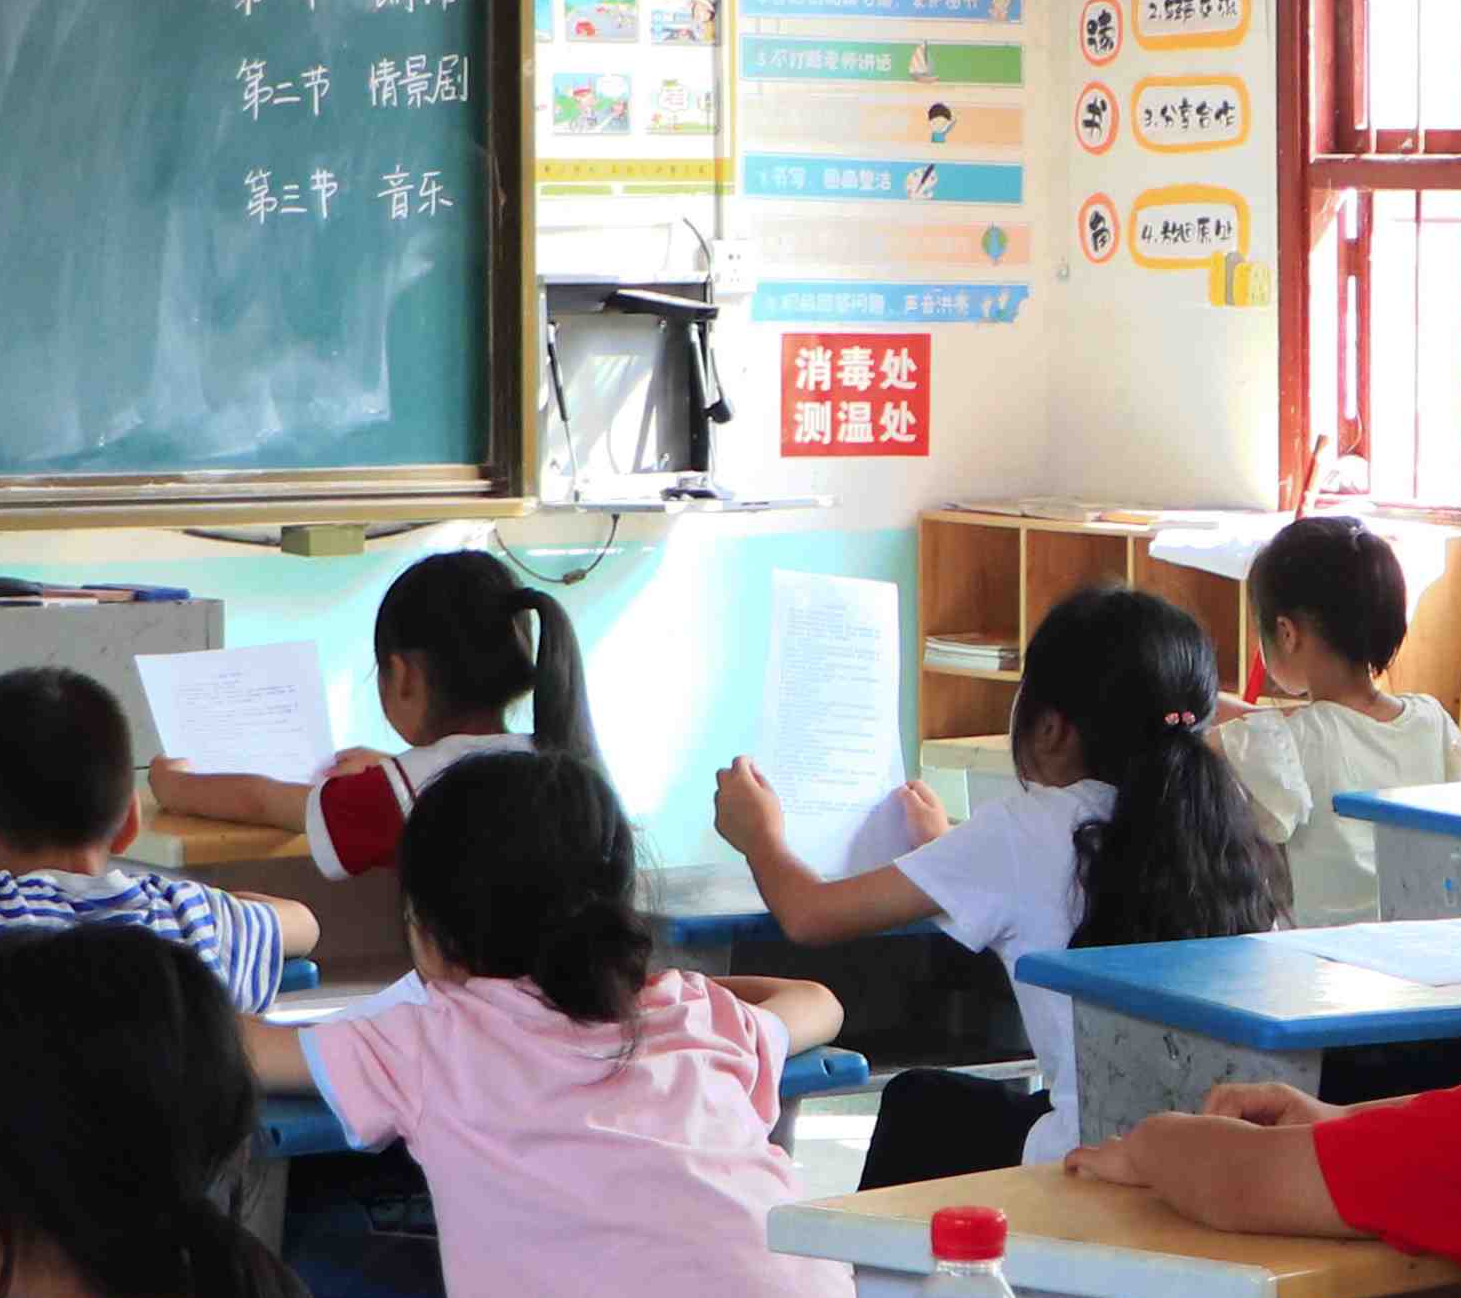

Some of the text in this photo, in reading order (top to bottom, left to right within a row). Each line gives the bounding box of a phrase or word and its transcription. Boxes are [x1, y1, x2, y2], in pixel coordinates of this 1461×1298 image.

[237, 54, 469, 121] 第二节 情景剧
[244, 165, 453, 225] 第三节 音乐
[795, 346, 918, 392] 消毒处
[793, 401, 918, 444] 测温处
